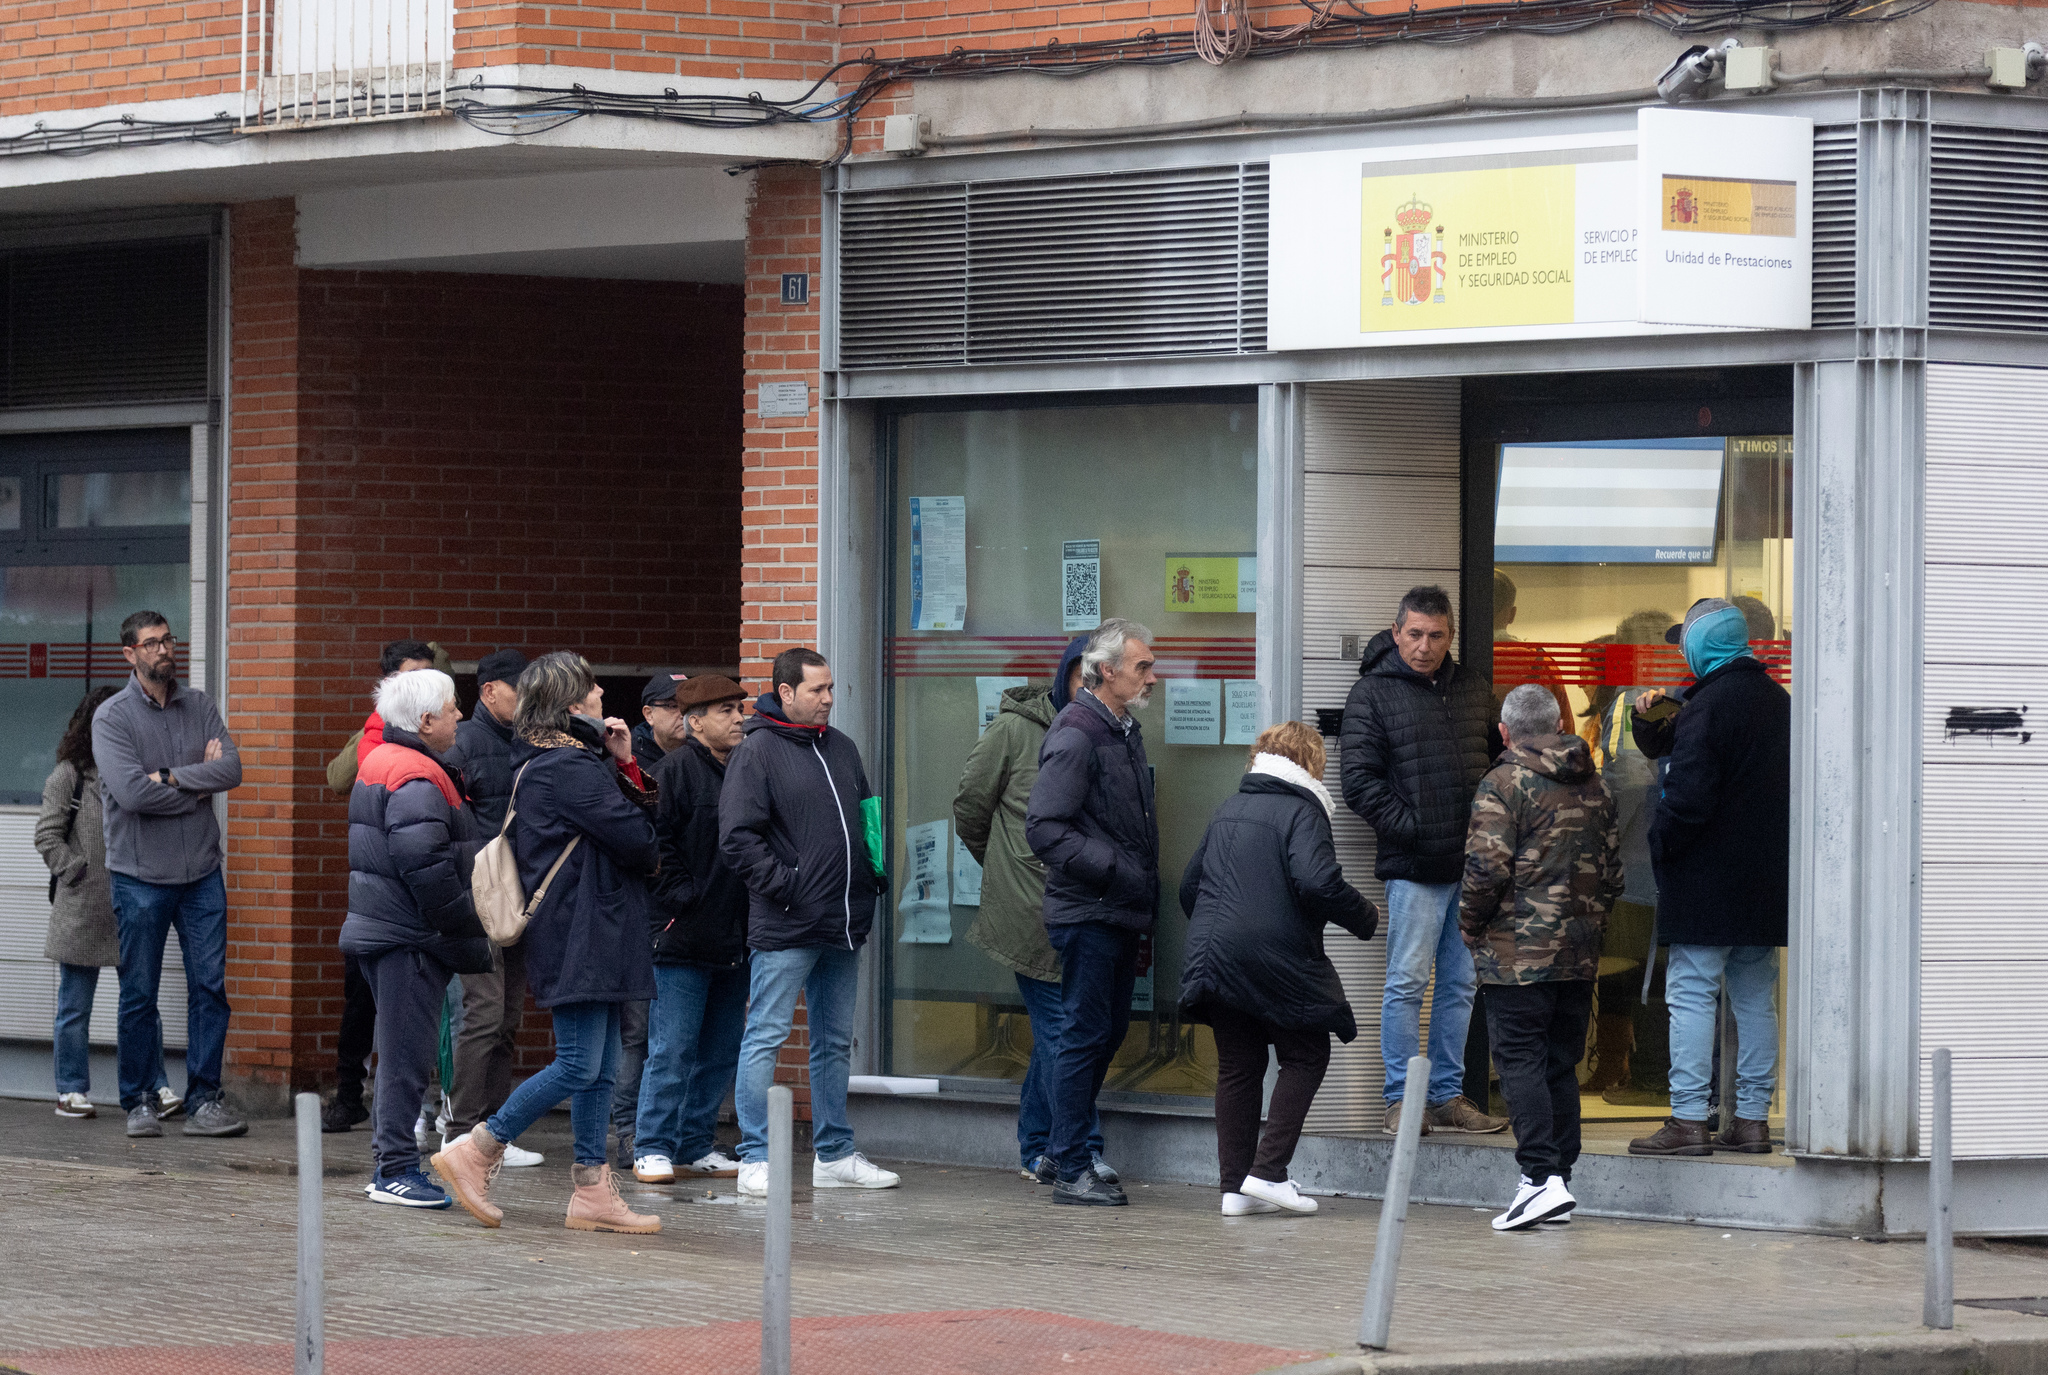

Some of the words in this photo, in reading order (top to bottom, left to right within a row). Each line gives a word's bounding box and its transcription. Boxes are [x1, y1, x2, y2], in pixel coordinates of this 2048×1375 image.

[1459, 230, 1519, 247] MINISTERIO
[1584, 229, 1629, 244] SERVICIO
[1459, 254, 1473, 267] DE
[1476, 251, 1517, 267] EMPLEO
[1584, 251, 1597, 264] DE
[1665, 249, 1704, 264] Unidad
[1707, 252, 1721, 265] de
[1724, 252, 1792, 269] Prestaciones
[1459, 274, 1466, 288] Y
[1468, 271, 1529, 287] SEGURIDAD
[1532, 269, 1571, 285] SOCIAL
[788, 277, 802, 300] 61
[1655, 549, 1686, 559] Recuerde
[1688, 550, 1700, 562] que
[1702, 549, 1712, 559] tal
